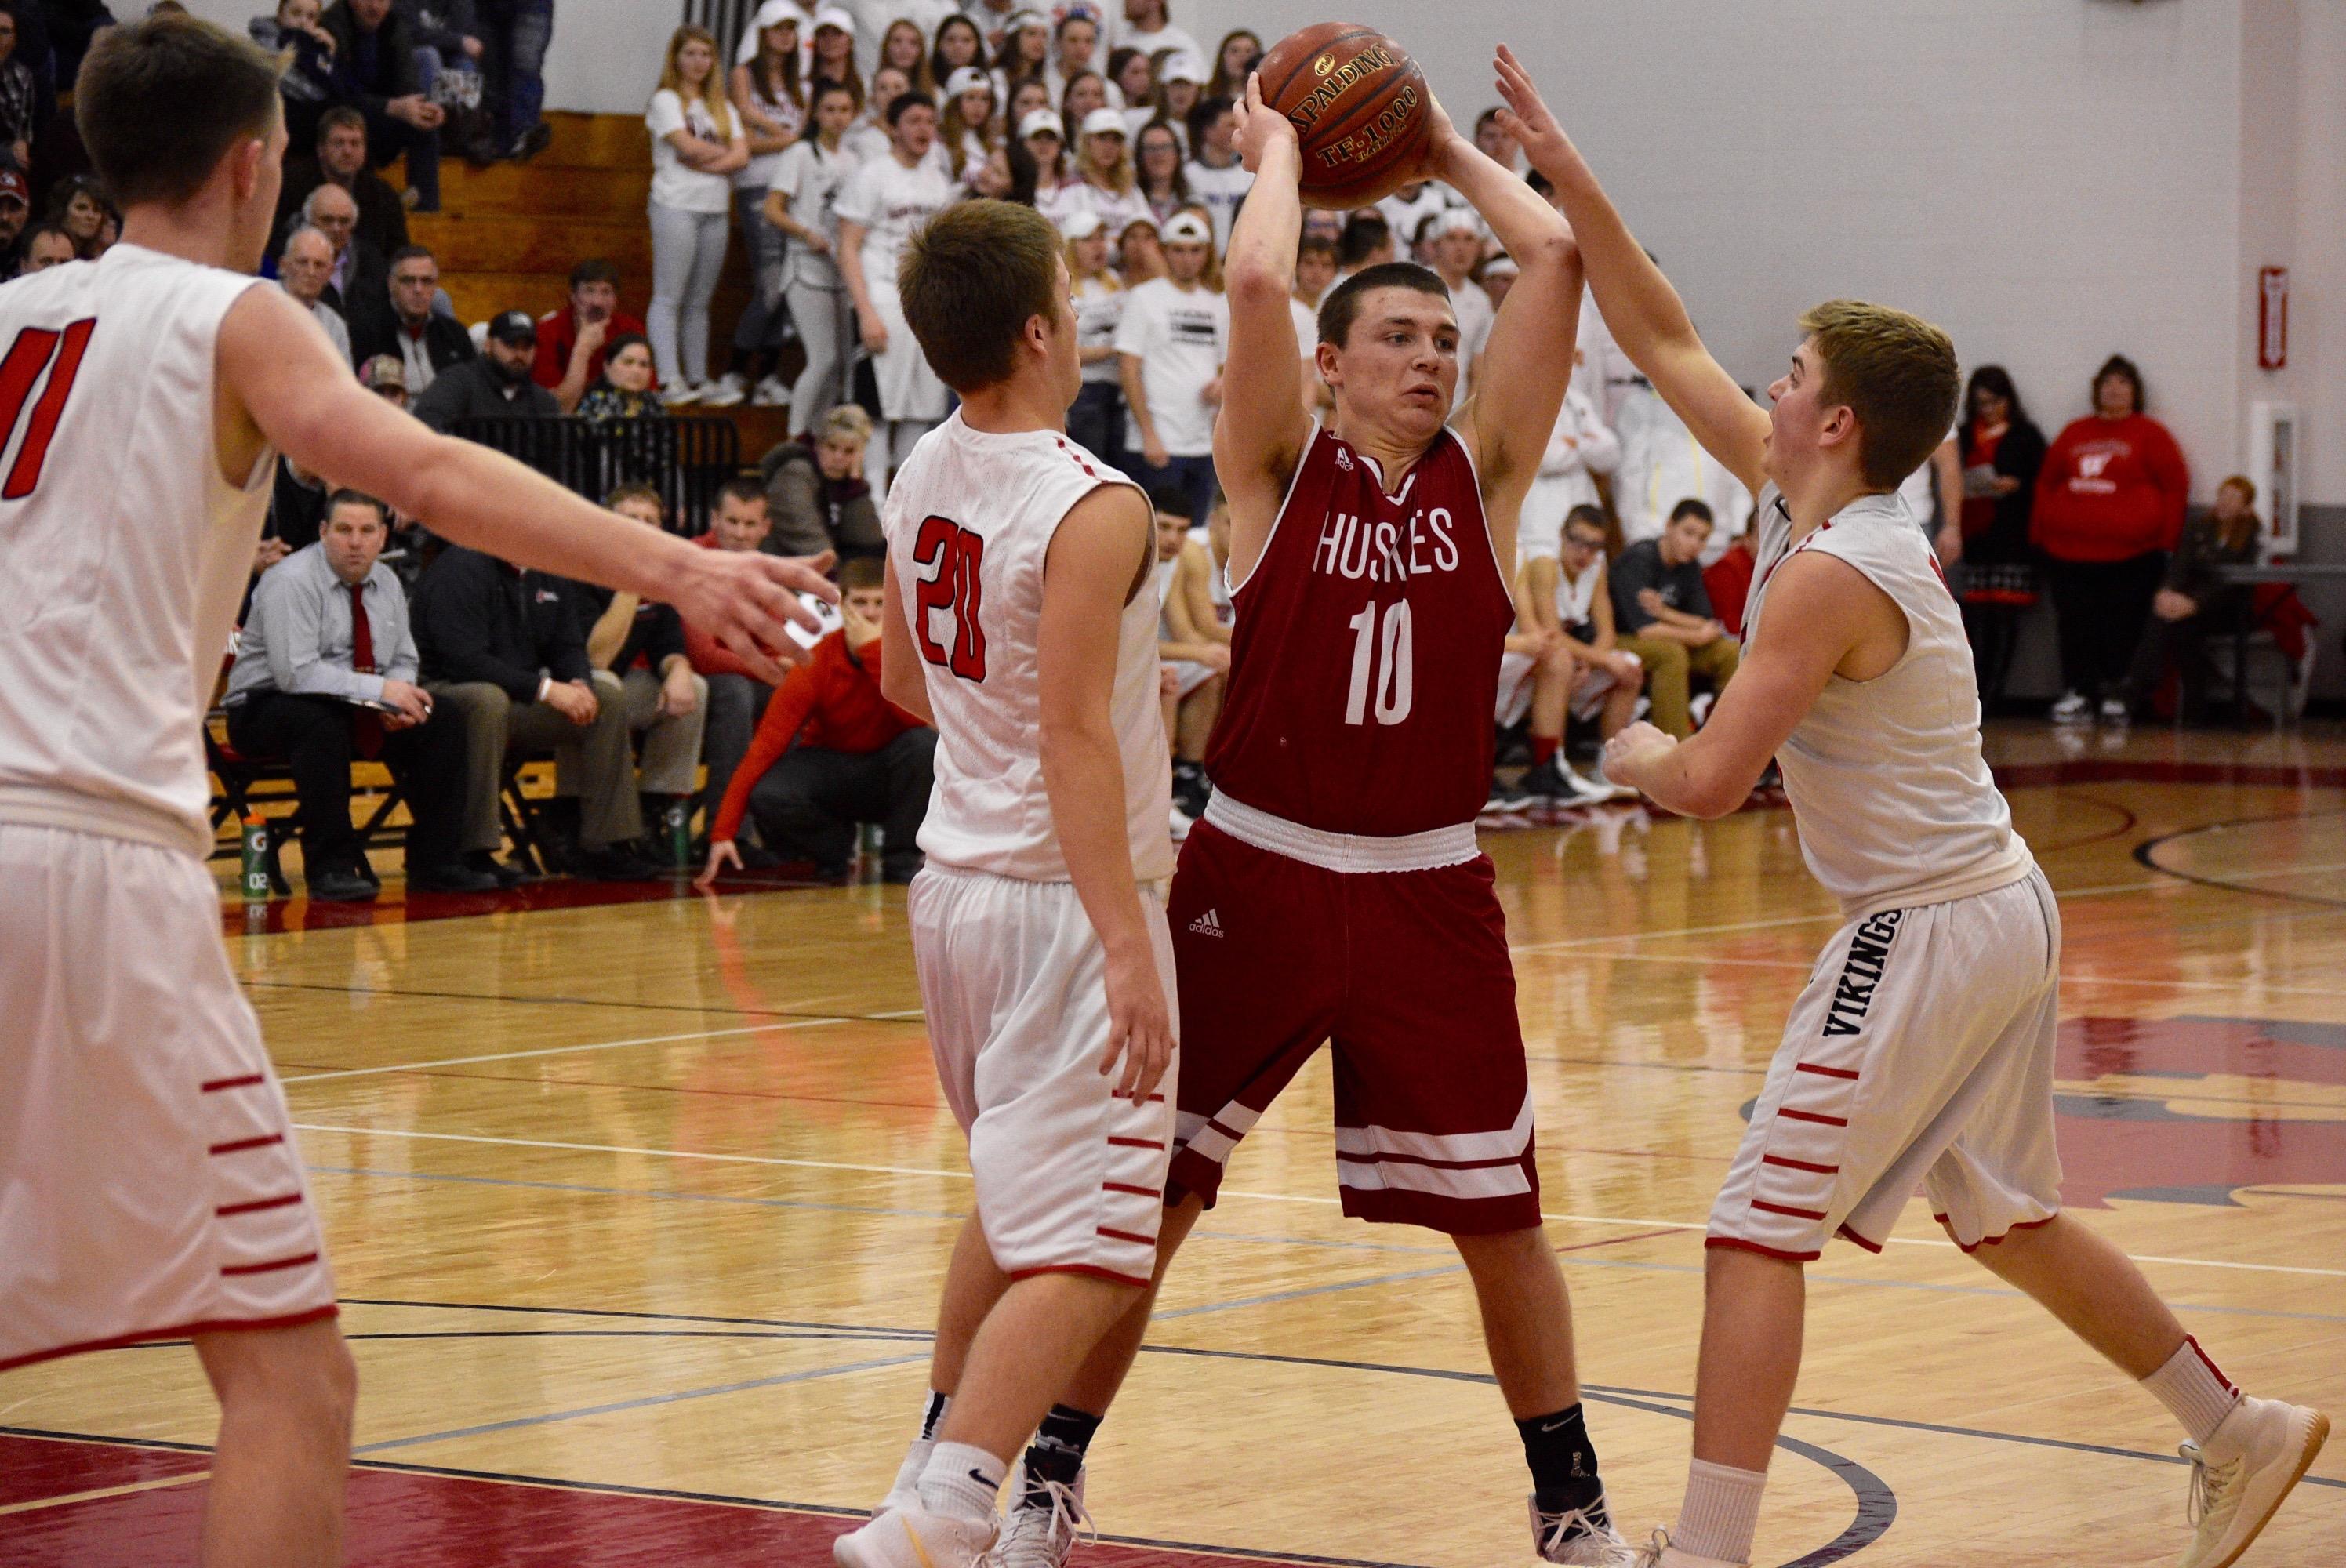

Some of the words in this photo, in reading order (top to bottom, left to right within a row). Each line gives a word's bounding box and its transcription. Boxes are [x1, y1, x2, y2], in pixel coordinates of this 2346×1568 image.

[1316, 85, 1418, 167] TF-1000
[1313, 506, 1458, 583] HUSKES
[913, 514, 986, 684] 20
[1345, 597, 1412, 725] 10
[1189, 923, 1224, 938] adidas
[1822, 909, 1903, 1036] VIKINGS
